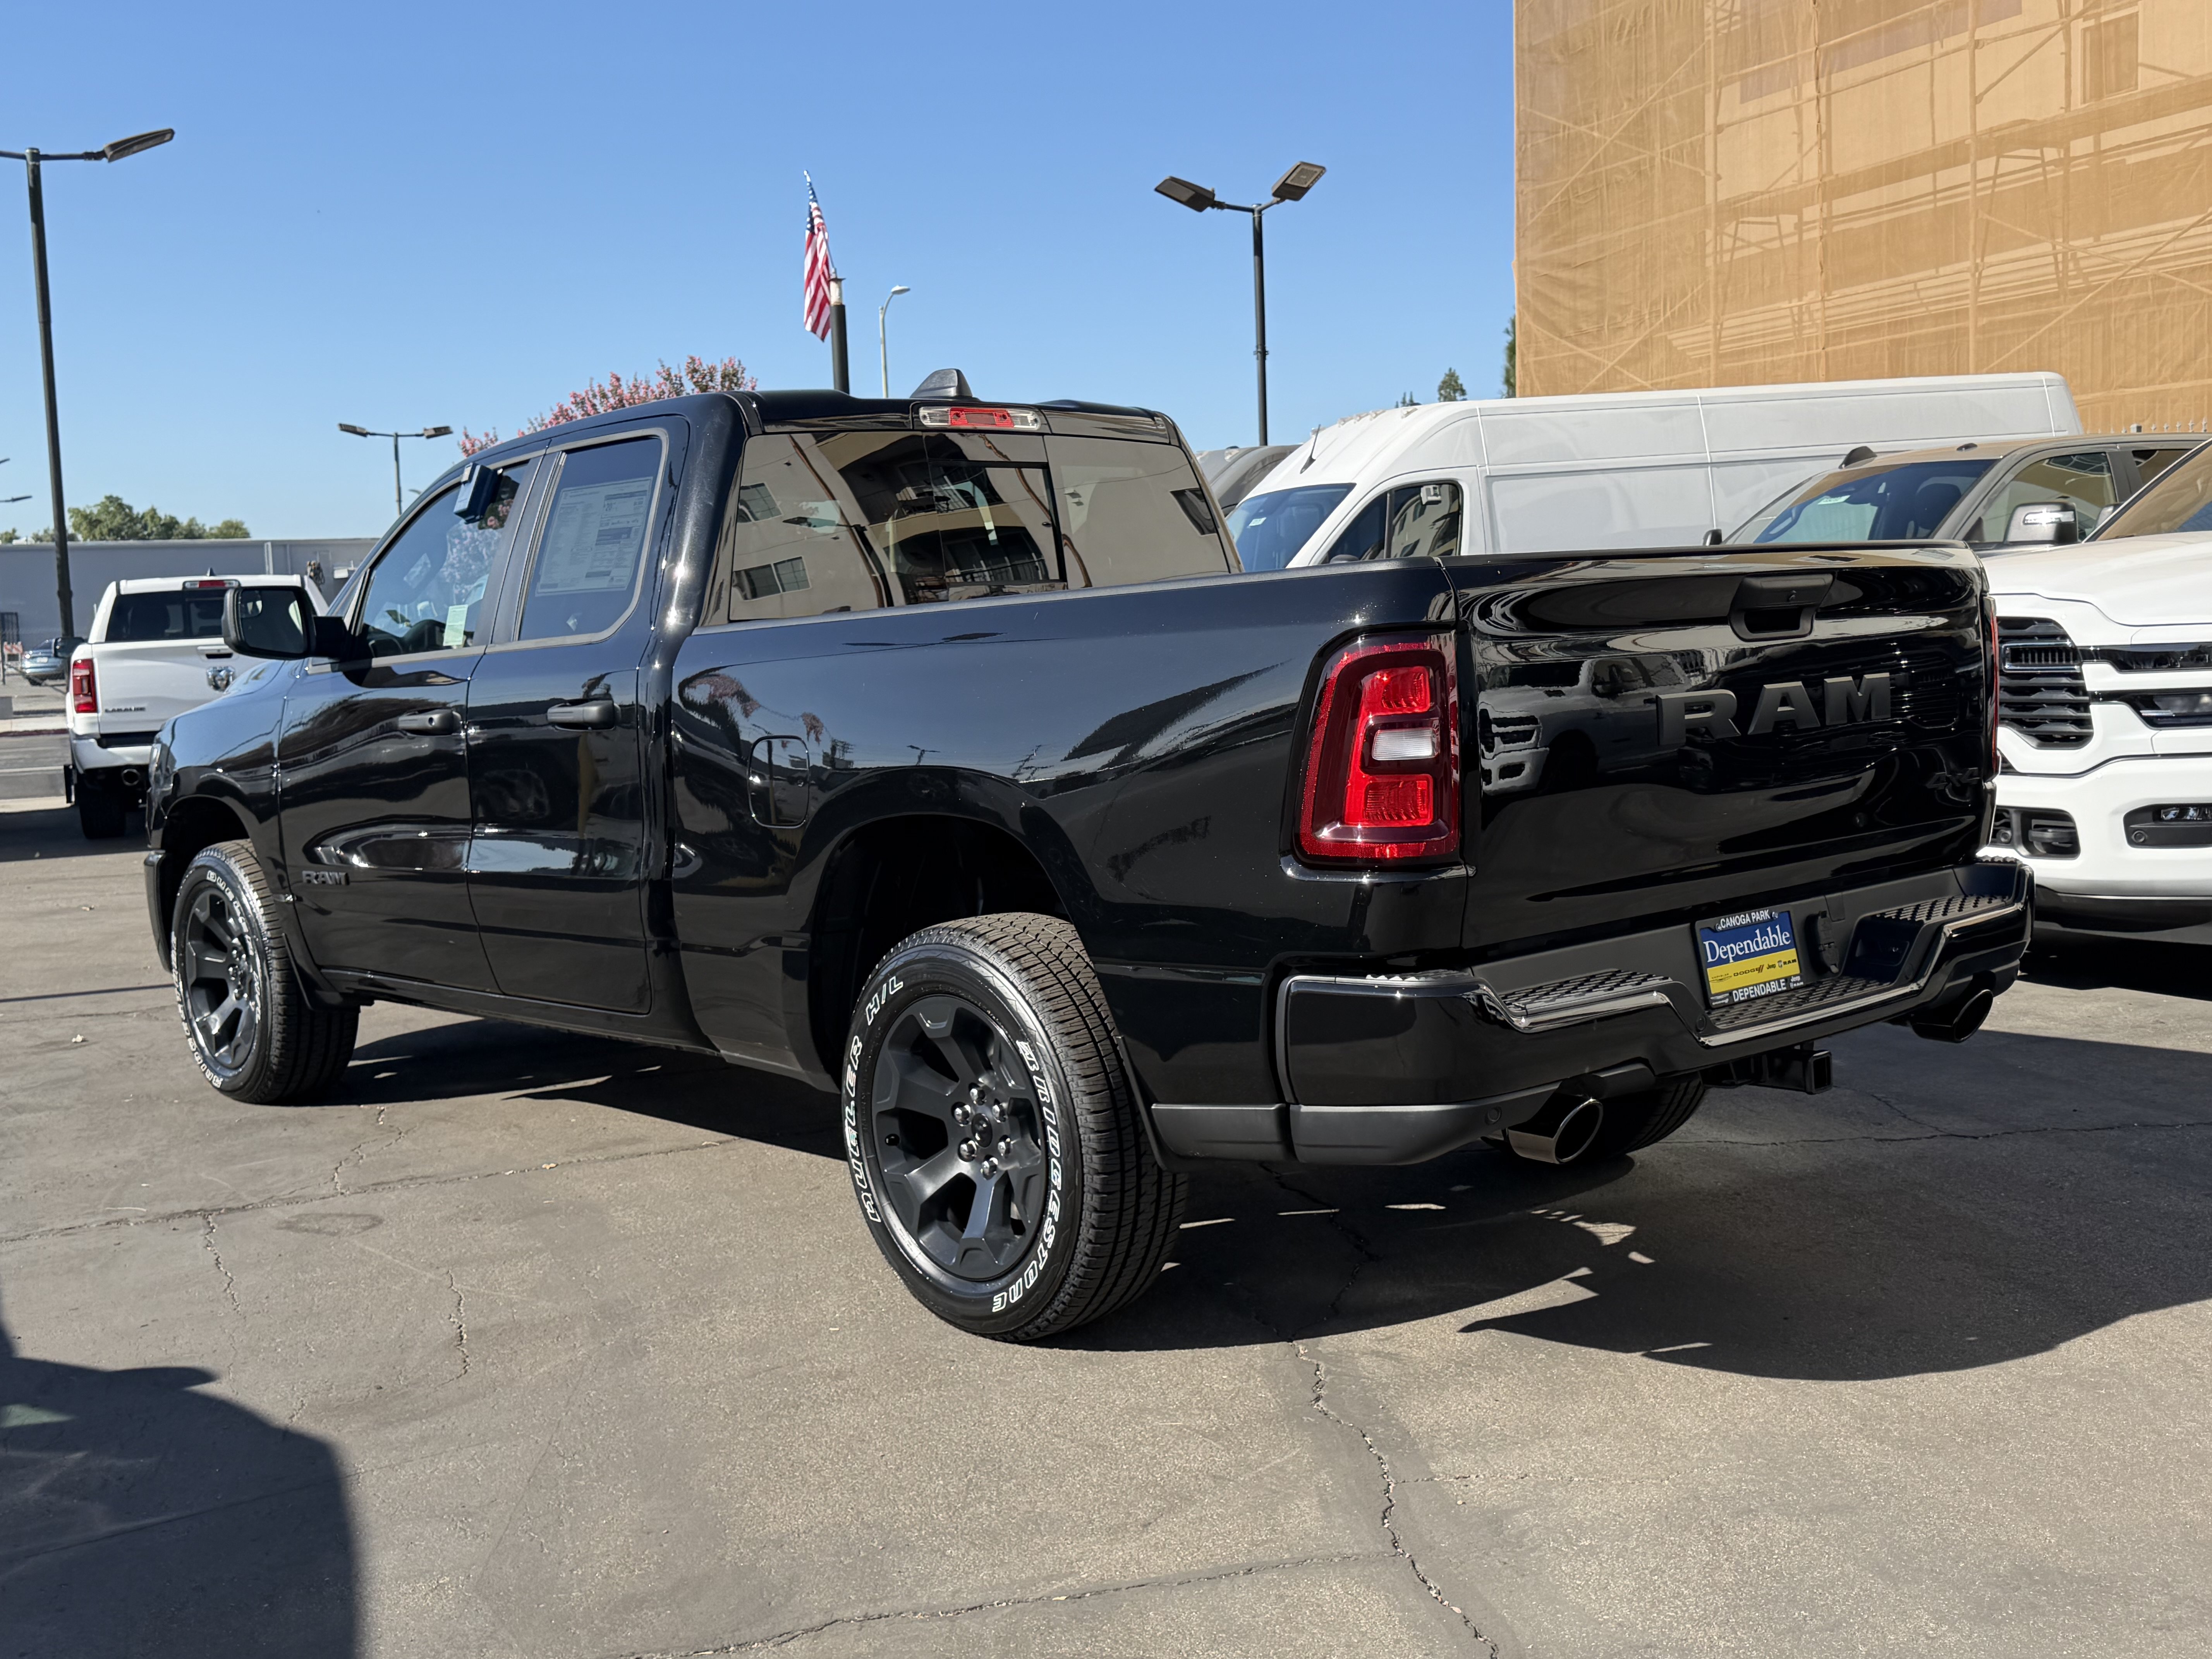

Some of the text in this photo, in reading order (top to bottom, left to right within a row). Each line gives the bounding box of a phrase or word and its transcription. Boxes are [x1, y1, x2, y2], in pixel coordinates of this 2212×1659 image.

[1656, 672, 1891, 746] RAM
[302, 871, 350, 886] RAM
[1720, 909, 1771, 929] CANOGA PARK
[1704, 924, 1791, 963] Dependable
[1733, 967, 1760, 976] DODGE
[1733, 979, 1786, 1002] DEPENDABLE
[844, 976, 903, 1223] DUELER H/L
[992, 1040, 1062, 1312] BRIDGESTONE
